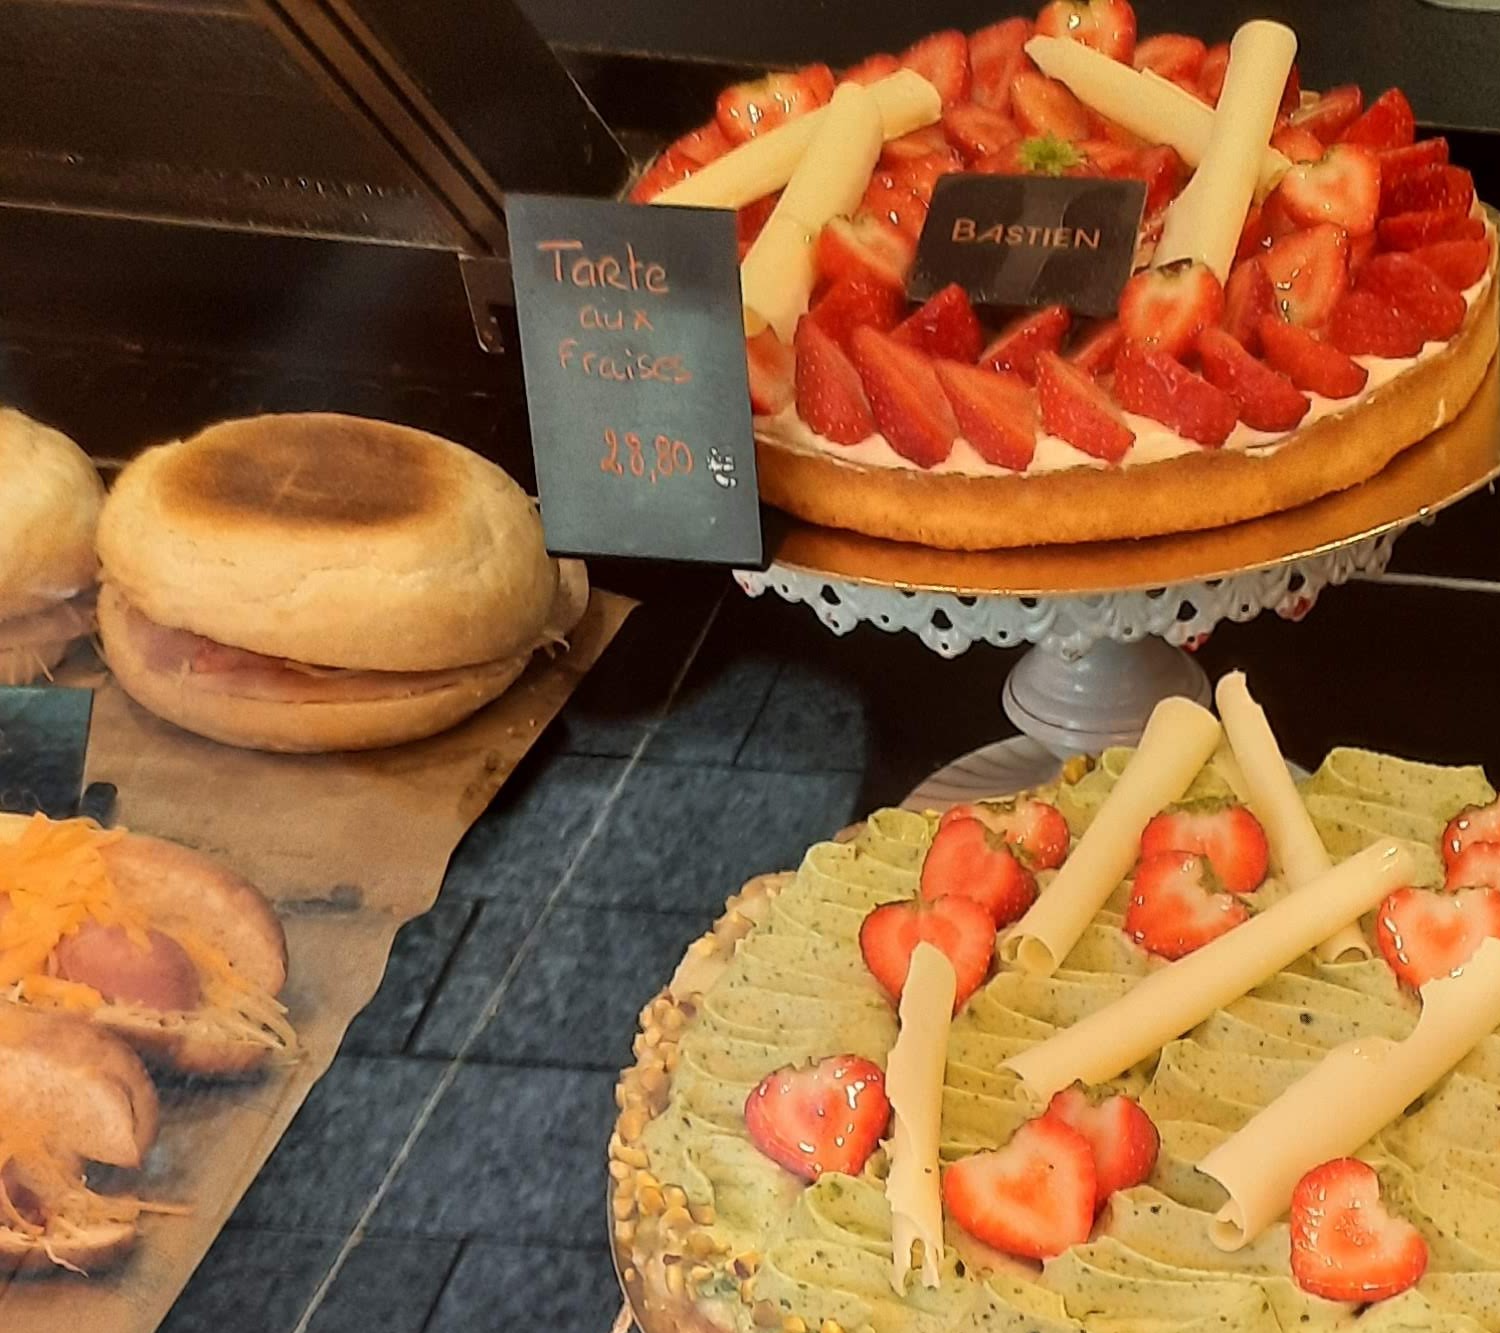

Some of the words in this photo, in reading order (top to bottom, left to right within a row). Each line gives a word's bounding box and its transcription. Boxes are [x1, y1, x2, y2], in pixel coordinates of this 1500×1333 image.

[952, 217, 1101, 250] BASTIEN
[537, 240, 670, 295] Tarte
[579, 306, 654, 332] aux
[600, 429, 695, 485] 28,80
